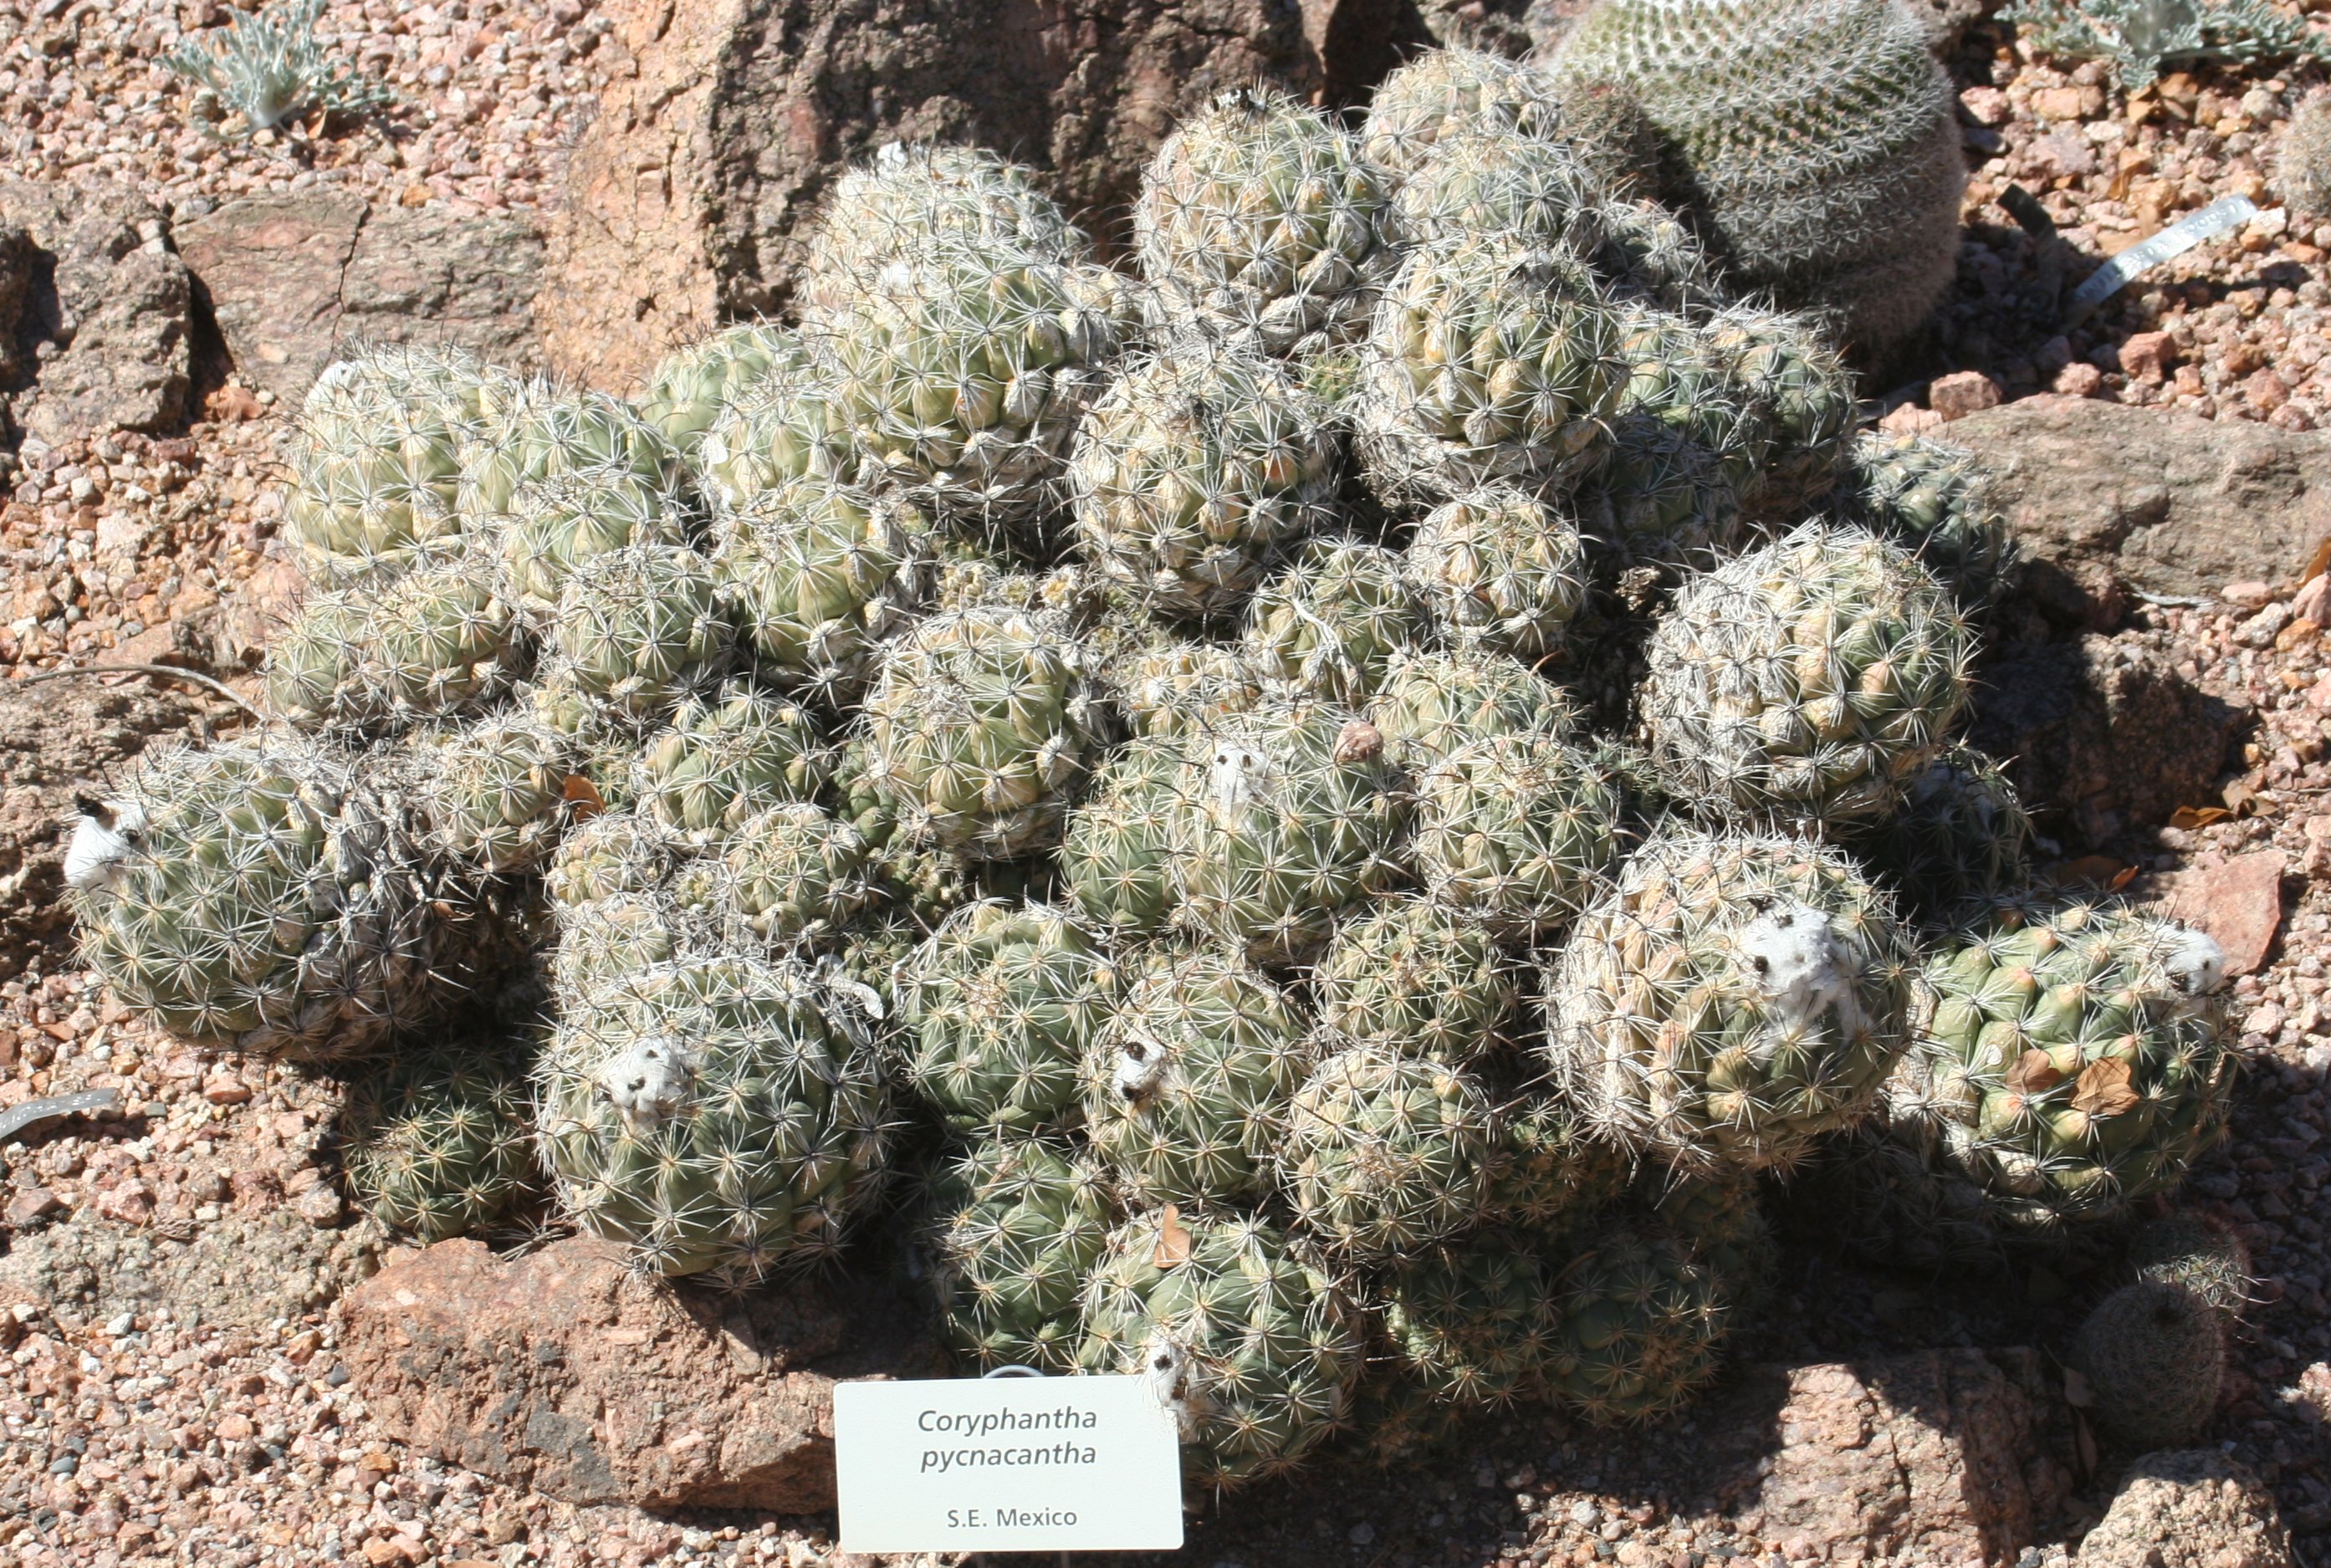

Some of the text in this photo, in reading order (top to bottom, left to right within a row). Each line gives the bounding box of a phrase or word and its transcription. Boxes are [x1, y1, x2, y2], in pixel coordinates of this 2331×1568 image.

[918, 1406, 1096, 1437] Coryphantha
[920, 1442, 1096, 1474] pycnacantha
[947, 1507, 1077, 1528] S.E. Mexico
